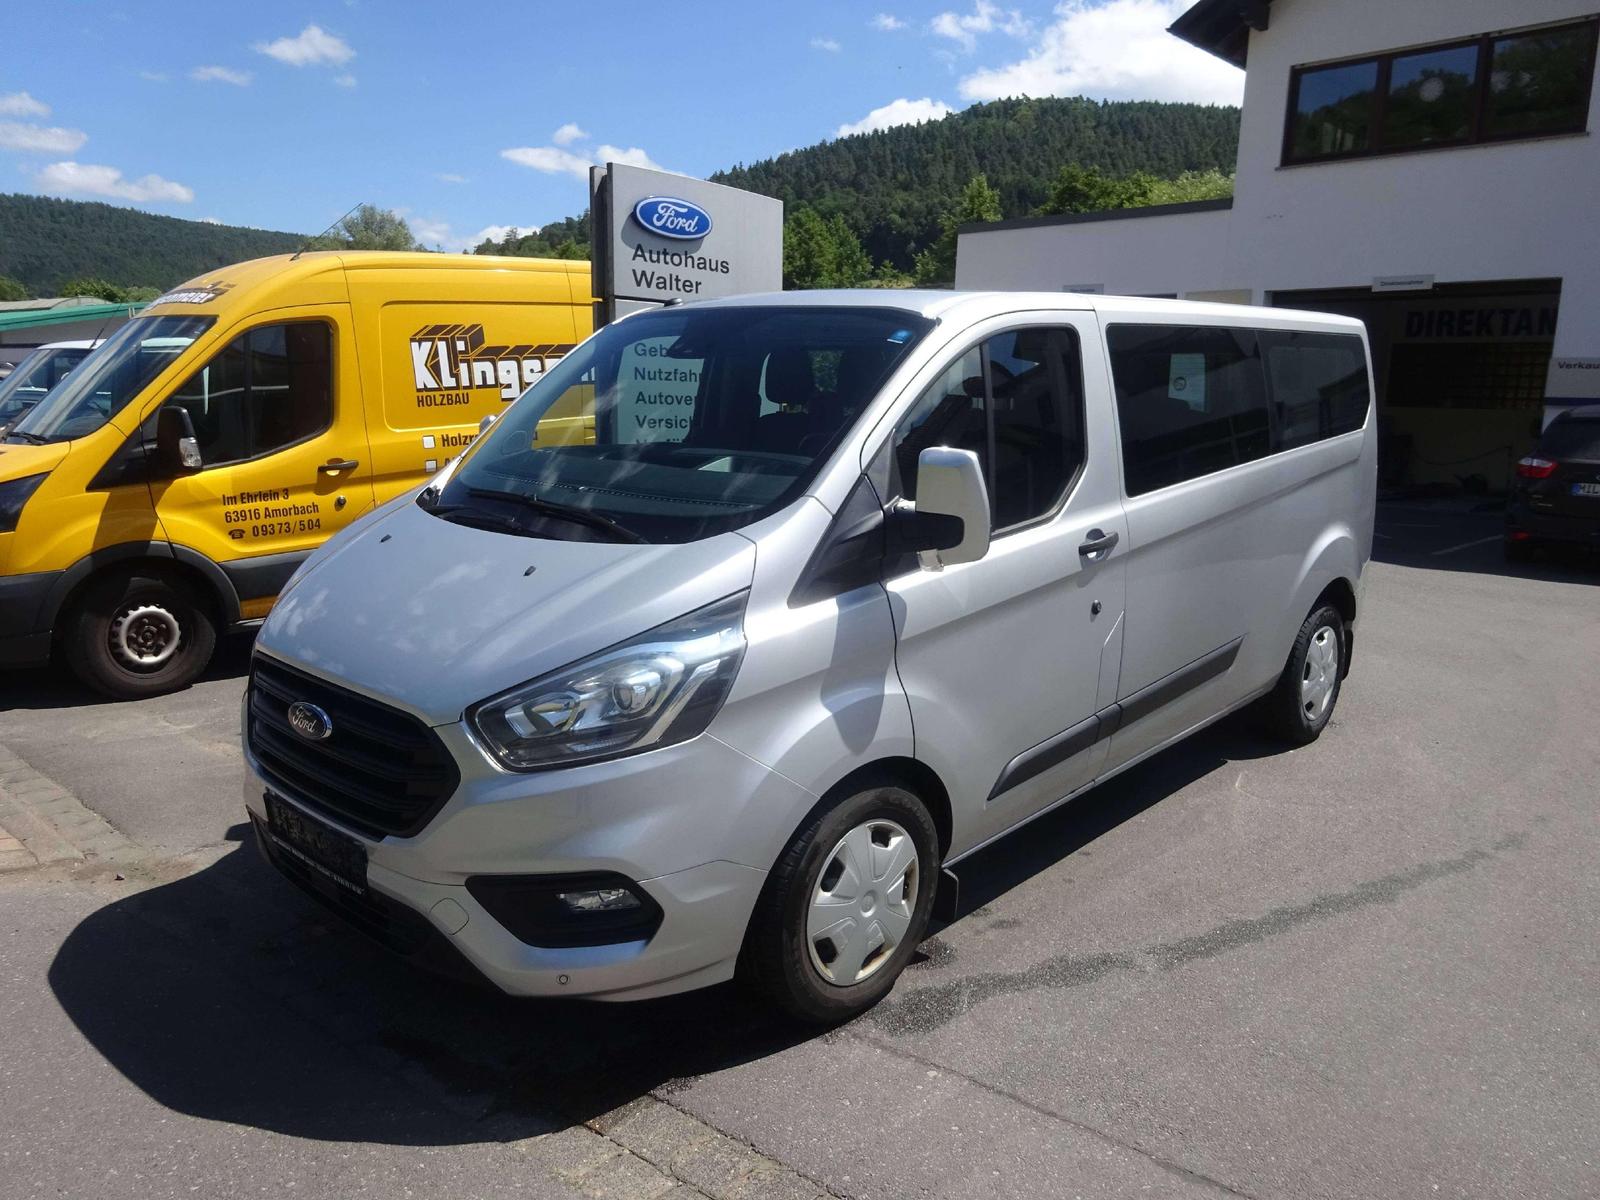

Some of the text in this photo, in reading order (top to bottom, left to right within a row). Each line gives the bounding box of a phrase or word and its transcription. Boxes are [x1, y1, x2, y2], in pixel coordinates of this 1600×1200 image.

[653, 203, 699, 232] Ford
[632, 243, 730, 274] Autohaus
[632, 268, 702, 294] Walter
[417, 393, 470, 407] HOLZBAU
[635, 391, 696, 406] Autove
[441, 433, 478, 447] Holzr
[222, 488, 289, 506] Im Ehrlein 3
[225, 502, 319, 523] 63916 Amorbach
[252, 518, 320, 537] 09373/504
[292, 706, 317, 733] Ford
